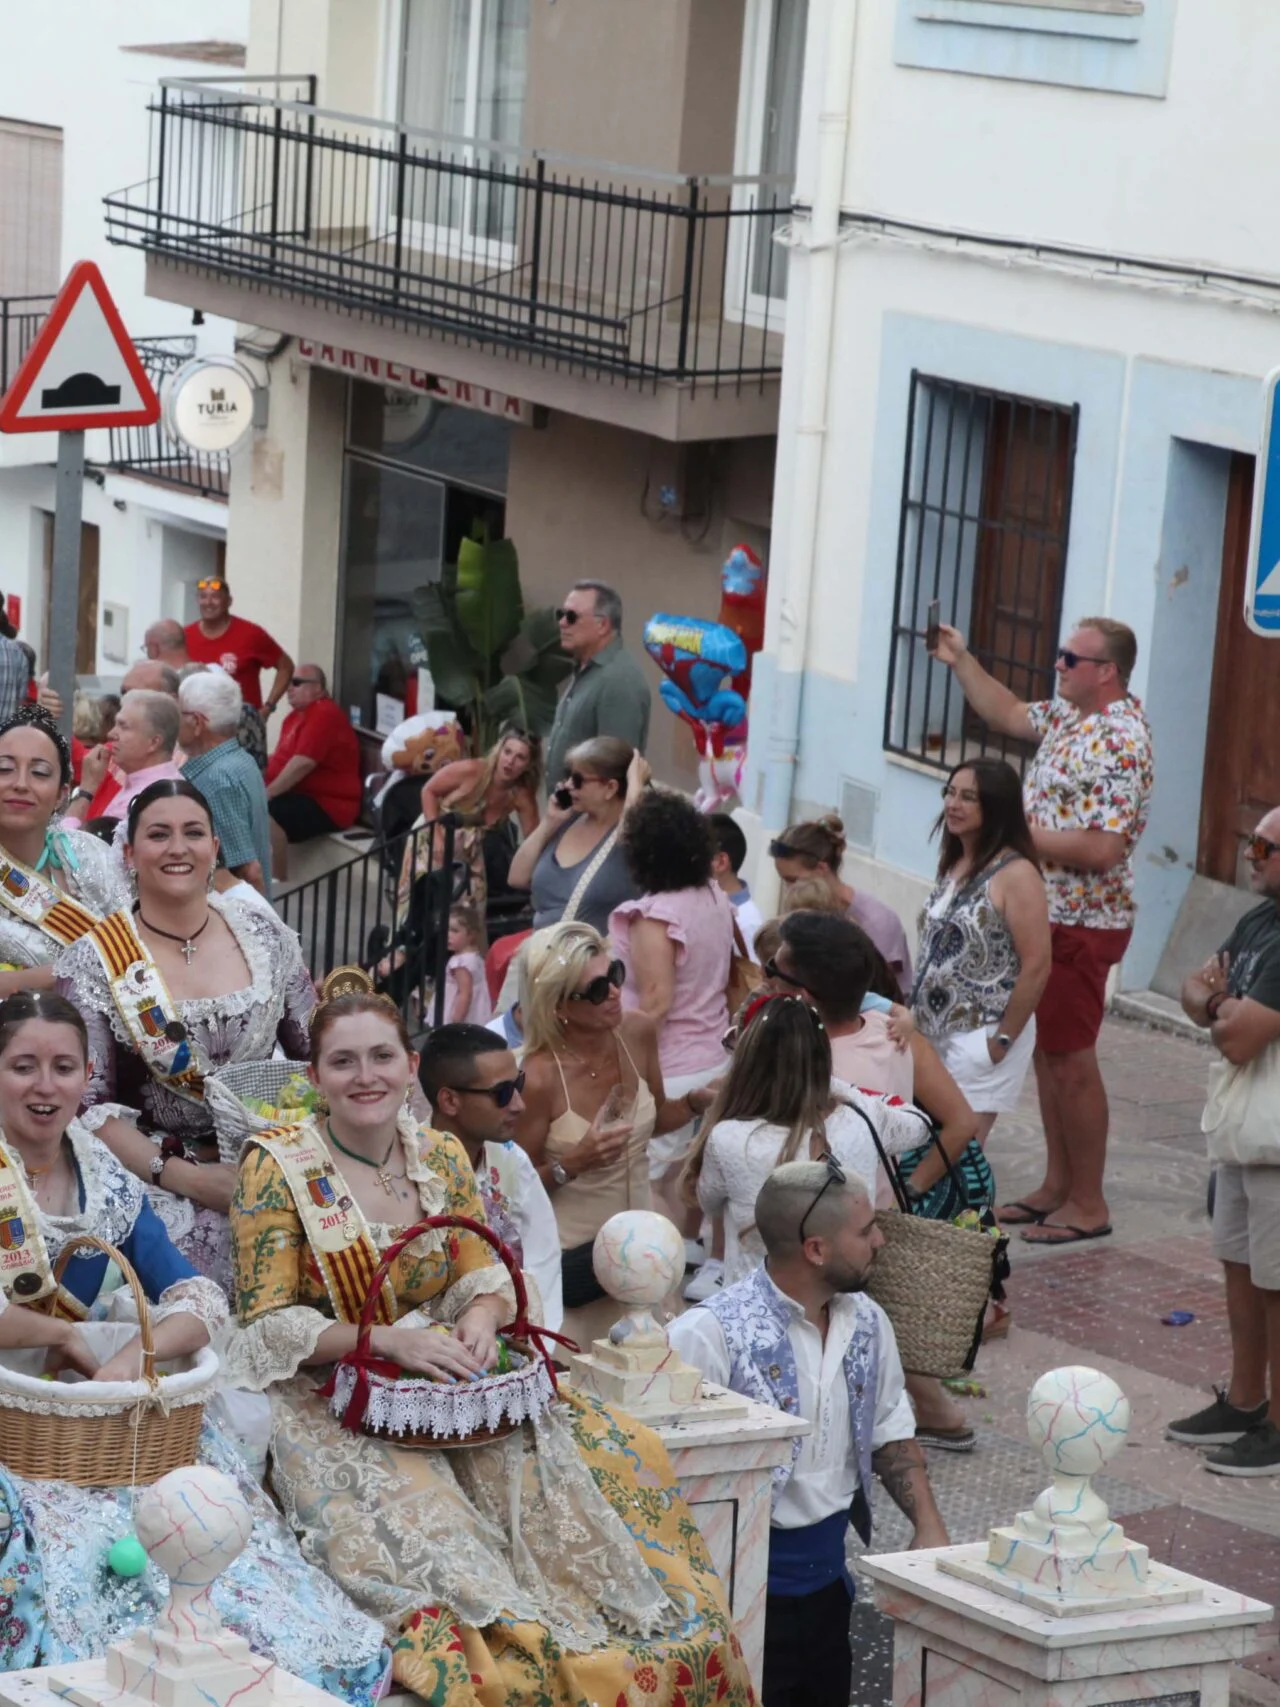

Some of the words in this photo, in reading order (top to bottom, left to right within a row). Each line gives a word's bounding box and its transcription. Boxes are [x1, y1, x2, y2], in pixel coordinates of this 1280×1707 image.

[197, 402, 238, 415] TURIA
[319, 1211, 349, 1231] 2013
[2, 1249, 31, 1264] 2013
